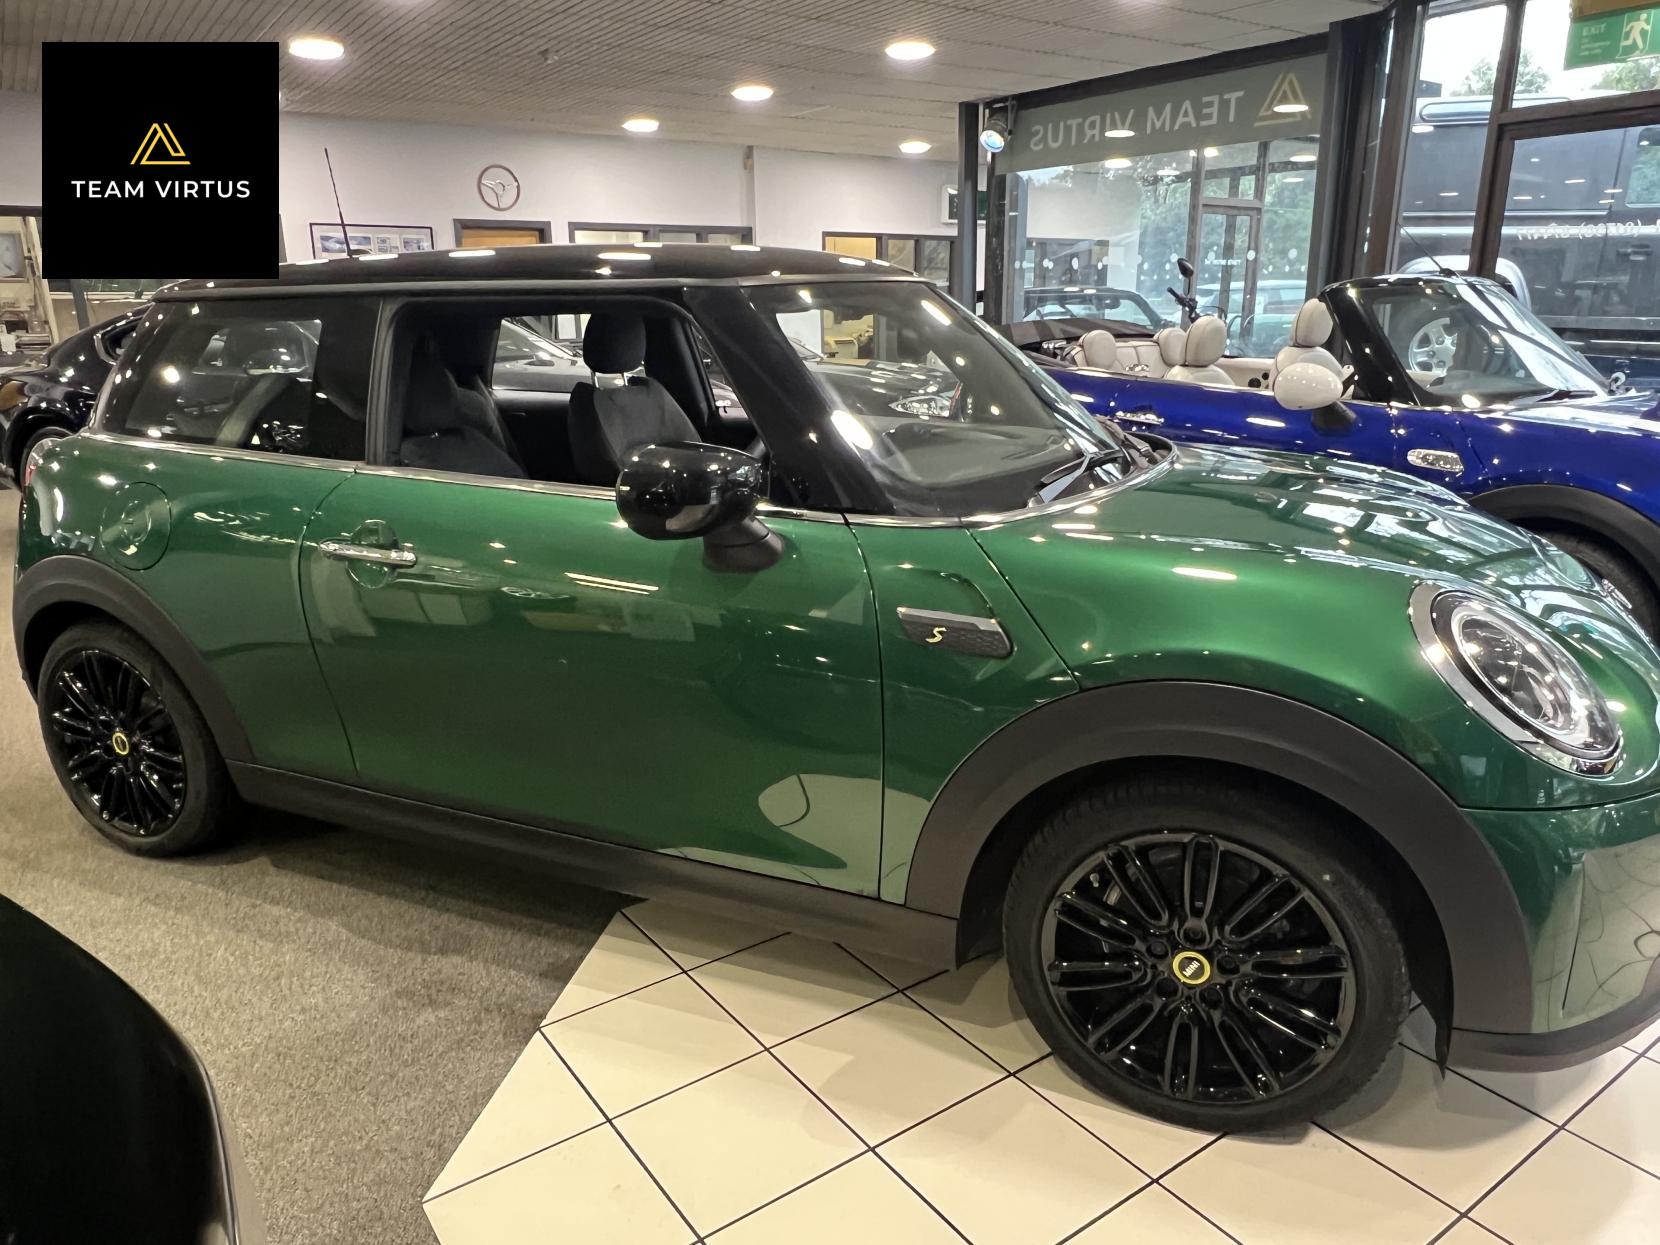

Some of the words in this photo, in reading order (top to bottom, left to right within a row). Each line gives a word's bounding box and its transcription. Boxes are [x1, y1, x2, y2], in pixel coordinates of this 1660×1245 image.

[1583, 22, 1607, 36] EXIT
[925, 626, 947, 643] S
[1182, 960, 1201, 977] MINI
